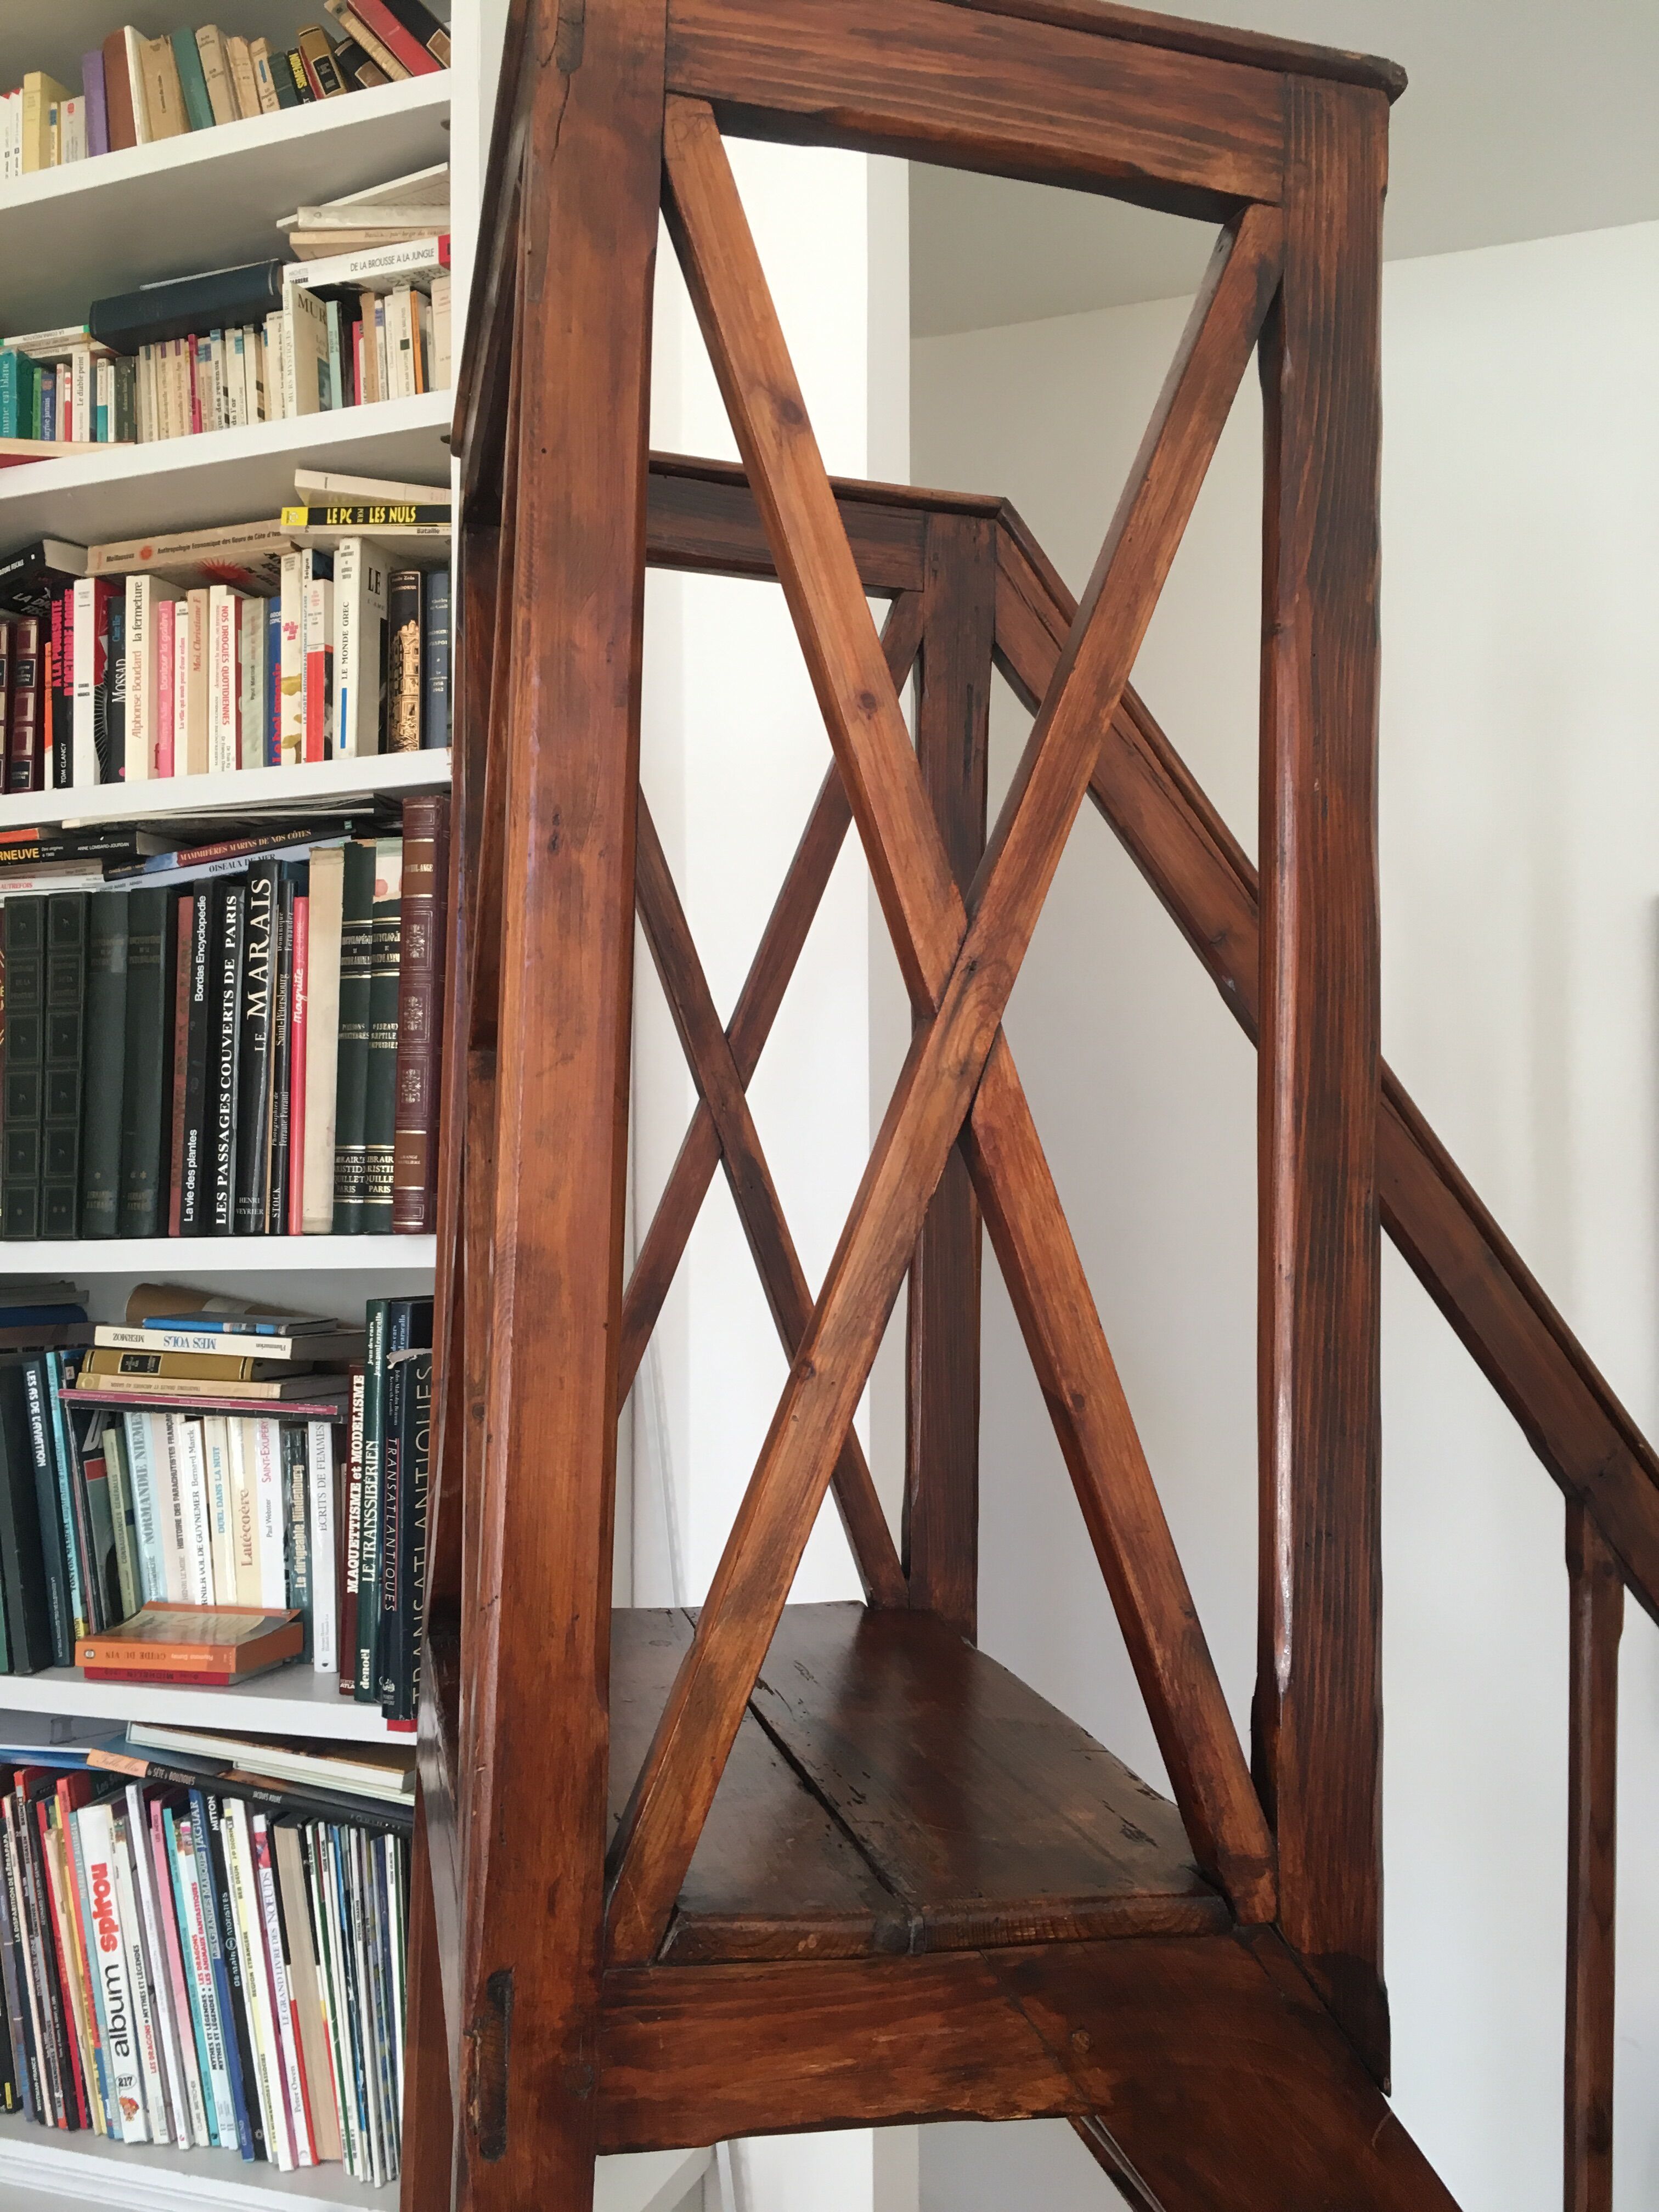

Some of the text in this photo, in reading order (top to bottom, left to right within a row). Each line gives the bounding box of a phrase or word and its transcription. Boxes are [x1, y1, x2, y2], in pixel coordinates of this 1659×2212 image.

[351, 248, 435, 272] DE LA BROUSSE A LA JUNGLE
[285, 330, 293, 376] MYSTIQUES
[1, 360, 10, 388] blanc
[77, 398, 83, 407] Le
[231, 415, 236, 426] de
[327, 506, 416, 524] LE PC LES NULS
[157, 543, 191, 555] Anthropologie
[367, 566, 381, 596] LE
[52, 599, 63, 658] POURSUITE
[193, 603, 201, 651] Christiane
[132, 582, 144, 739] Alphonse Boudard la fermeture
[159, 642, 168, 690] Bonjour la
[221, 605, 230, 726] NOS DROGUES QUOTIDIENNES
[341, 668, 348, 681] LE
[89, 842, 129, 851] LOMBARD-JOURDAN
[180, 828, 312, 861] MAMMIFÈRES MARINS DE NOS CÔTES
[209, 859, 242, 873] OISEAUX
[0, 882, 33, 890] AUTREFOIS
[195, 895, 207, 1002] Bordas Encyclopédie
[246, 878, 272, 1052] LE MARAIS
[276, 973, 290, 1047] Saint-Pétersbourg
[293, 968, 308, 1024] Magritte
[216, 895, 237, 1224] LES PASSAGES COUVERTS DE PARIS
[184, 1129, 198, 1222] La vie des plantes
[368, 1185, 391, 1193] PARIS
[272, 1187, 281, 1218] STOCK
[112, 1333, 145, 1344] MERMOZ
[163, 1335, 216, 1350] MES VOLS
[26, 1370, 46, 1468] LES AS DE L'AVIATION
[188, 1429, 196, 1455] Marck
[168, 1445, 181, 1501] PARACHUTISTES
[212, 1446, 226, 1535] DUEL DANS LA NUIT
[315, 1424, 328, 1532] ECRITS DE FEMMES
[347, 1374, 365, 1594] MAQUETTISME et MODELISME
[136, 1463, 154, 1545] NORMANDIE
[191, 1489, 203, 1544] GUYNEMER
[362, 1440, 379, 1583] LE TRANSSIBÉRIEN
[115, 1510, 128, 1564] CONNAISSANCES
[176, 1518, 185, 1550] HISTOIRE
[239, 1487, 253, 1568] Latécoère
[292, 1464, 307, 1589] Le dirigeable Hindenburg
[385, 1437, 398, 1612] TRANSATLANTIQUES
[196, 1543, 204, 1558] DE
[198, 1558, 206, 1577] VOL
[359, 1648, 370, 1690] denoël
[190, 1799, 204, 1849] JAGUAR
[208, 1795, 219, 1831] MITTON
[8, 1876, 21, 1943] LA DISPARITION DE
[91, 1862, 120, 1954] spirou
[191, 1881, 204, 1935] FANTASTIQUES
[192, 1934, 202, 1972] DRAGONS
[199, 1936, 210, 1971] ANIMAUX
[271, 1927, 280, 1945] DES
[133, 1943, 142, 1976] LÉGENDES
[243, 1931, 257, 1998] REGION ETRANGERE
[273, 1946, 284, 1975] LIVRE
[136, 1976, 142, 1984] ET
[278, 1976, 289, 2013] GRAND
[105, 1963, 130, 2058] album
[138, 1985, 149, 2019] MYTHES
[201, 1994, 212, 2030] LÉGENDES
[208, 1994, 218, 2030] LÉGENDES
[281, 2013, 290, 2026] LE
[144, 2024, 156, 2061] DRAGONS
[208, 2032, 212, 2040] ET
[215, 2032, 219, 2040] ET
[208, 2042, 217, 2070] MYTHES
[216, 2042, 224, 2070] MYTHES
[117, 2076, 133, 2087] 217
[289, 2065, 303, 2114] Peter Owen
